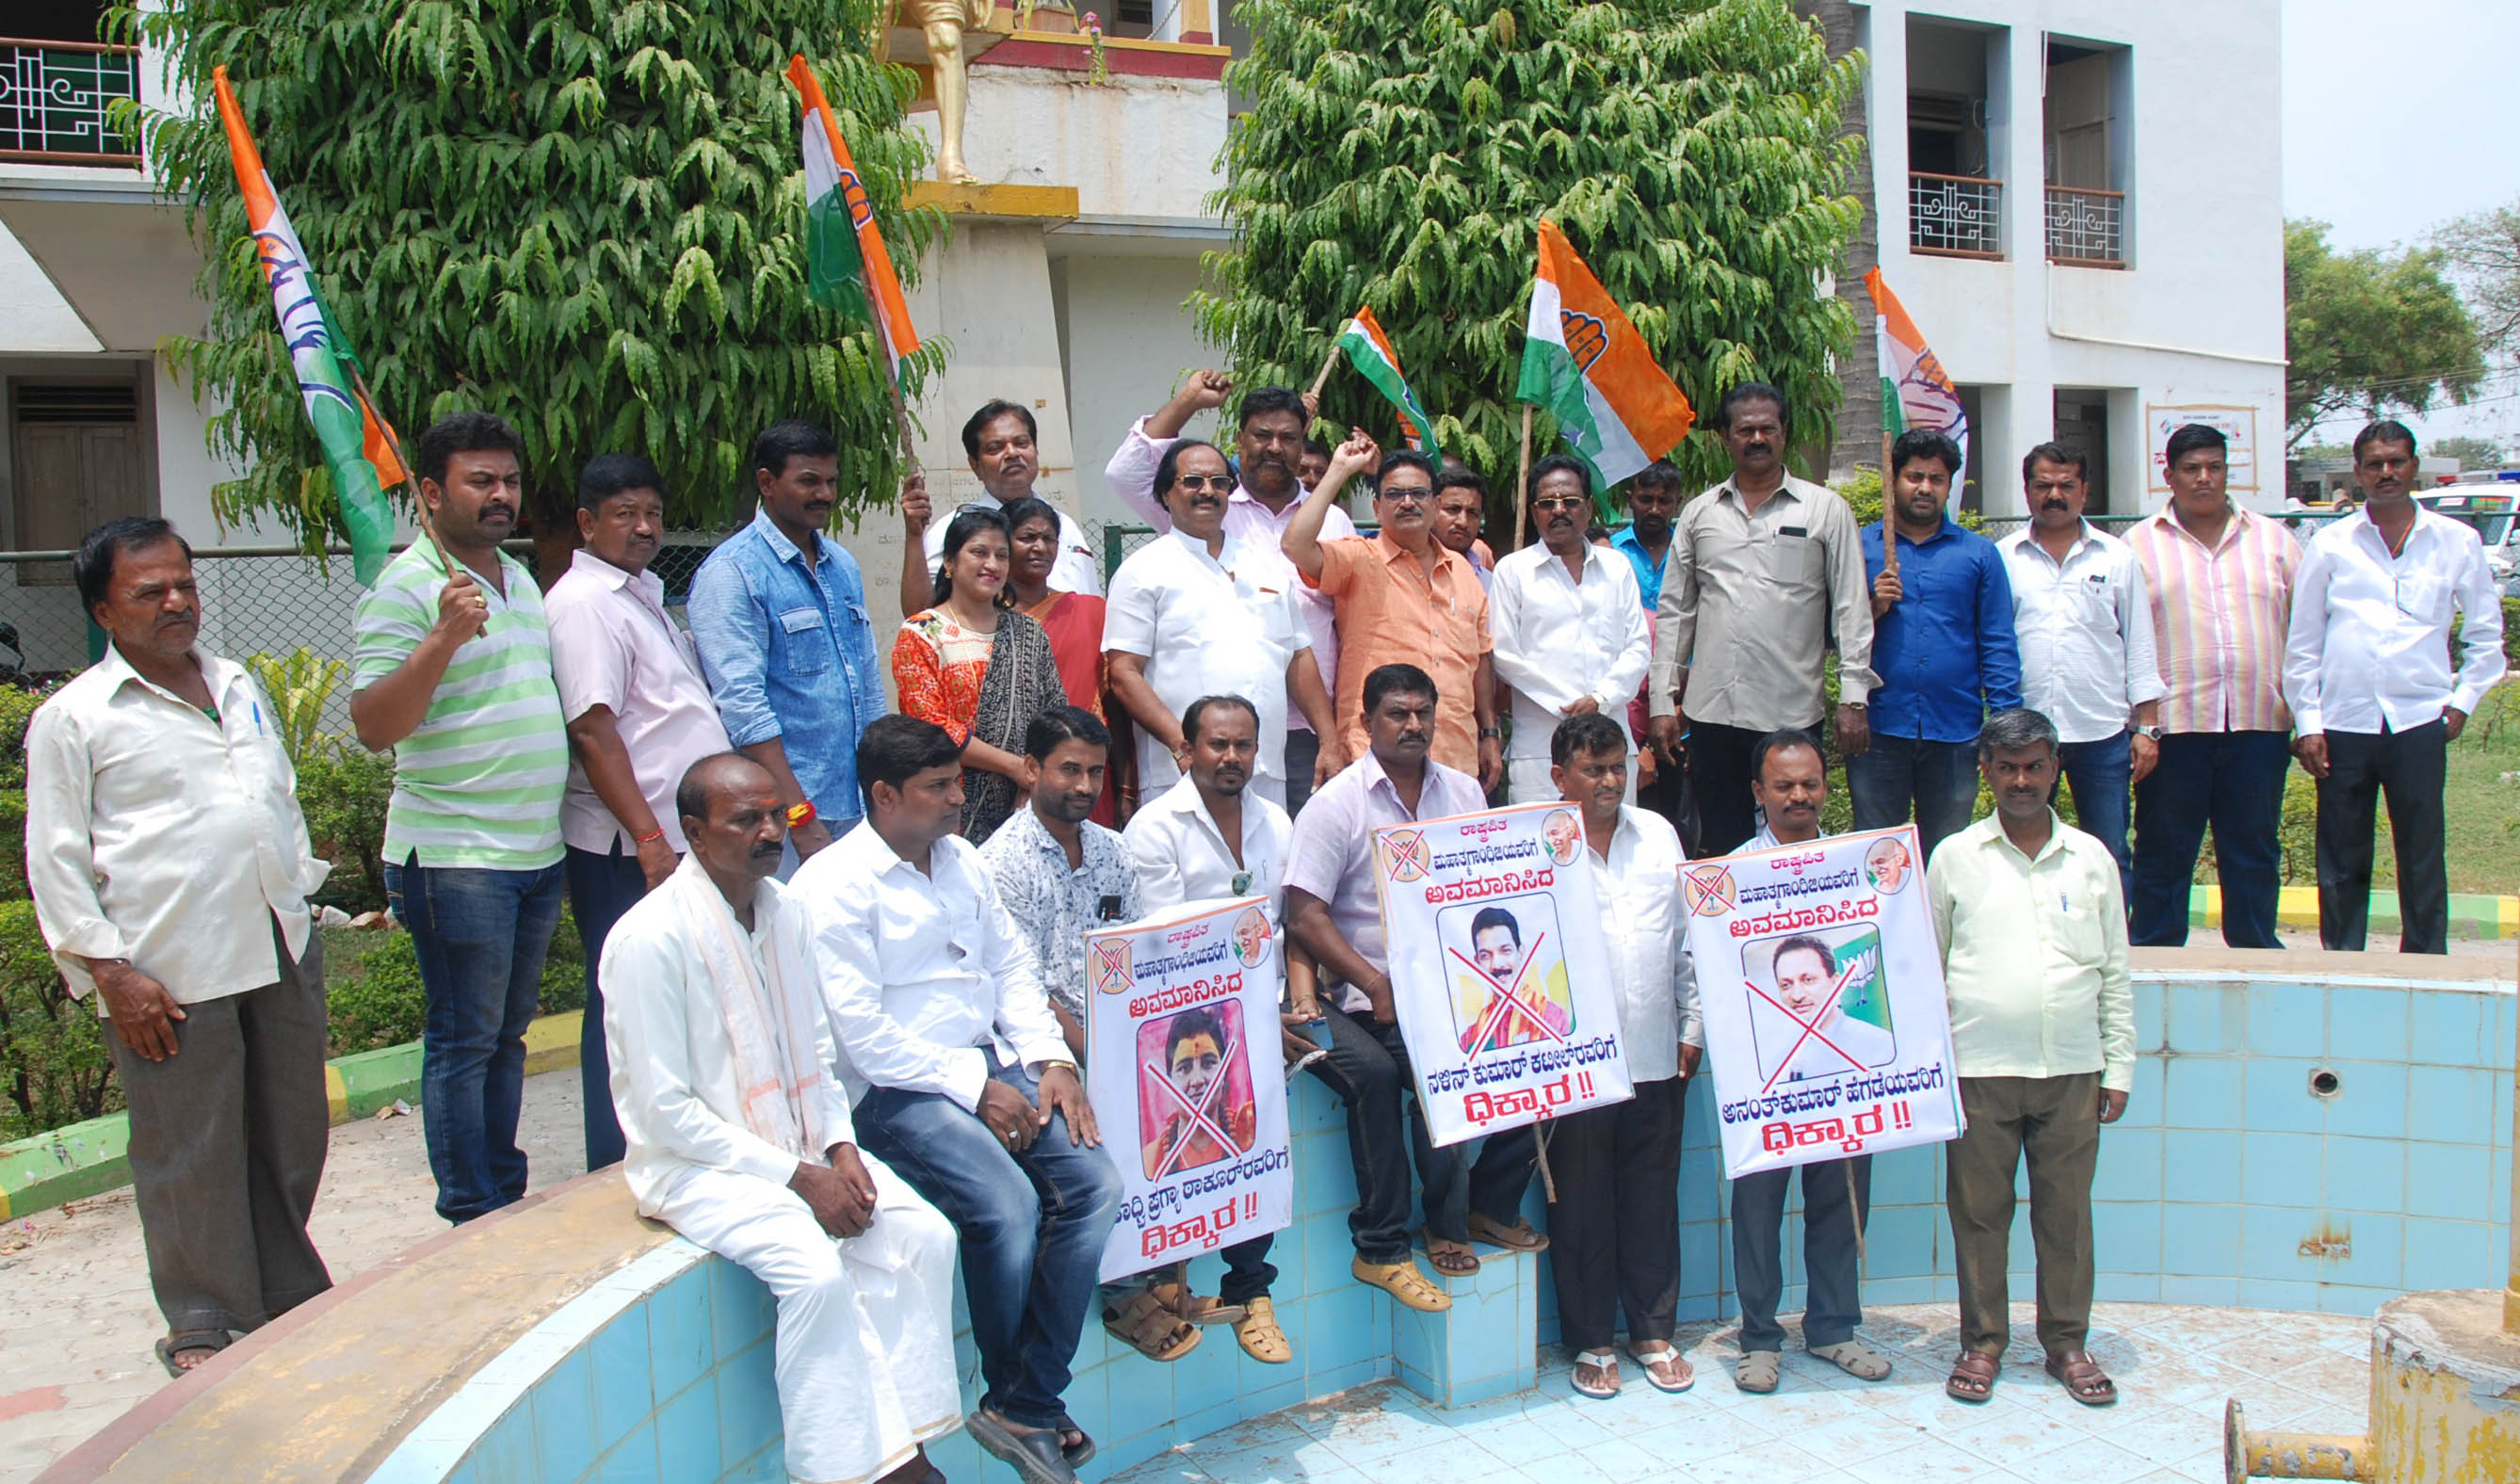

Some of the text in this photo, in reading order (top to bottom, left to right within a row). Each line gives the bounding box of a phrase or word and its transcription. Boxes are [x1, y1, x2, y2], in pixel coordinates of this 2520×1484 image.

[1425, 869, 1555, 904] ಅವಮಾನಿಸಿದ
[1730, 895, 1879, 938] ಅವಮಾನಿಸಿದ
[1130, 969, 1243, 1018] ಅವಮಾನಿಸಿದ
[1473, 1051, 1527, 1085] ಕುಮಾರ್
[1577, 1071, 1595, 1099] !!
[1846, 1062, 1943, 1103] ಹೆಗಡೆಯವರಿಗೆ
[1761, 1100, 1912, 1155] ಧಿಕ್ಕಾರ !!
[1142, 1192, 1257, 1258] ಧಿಕ್ಕಾರ !!
